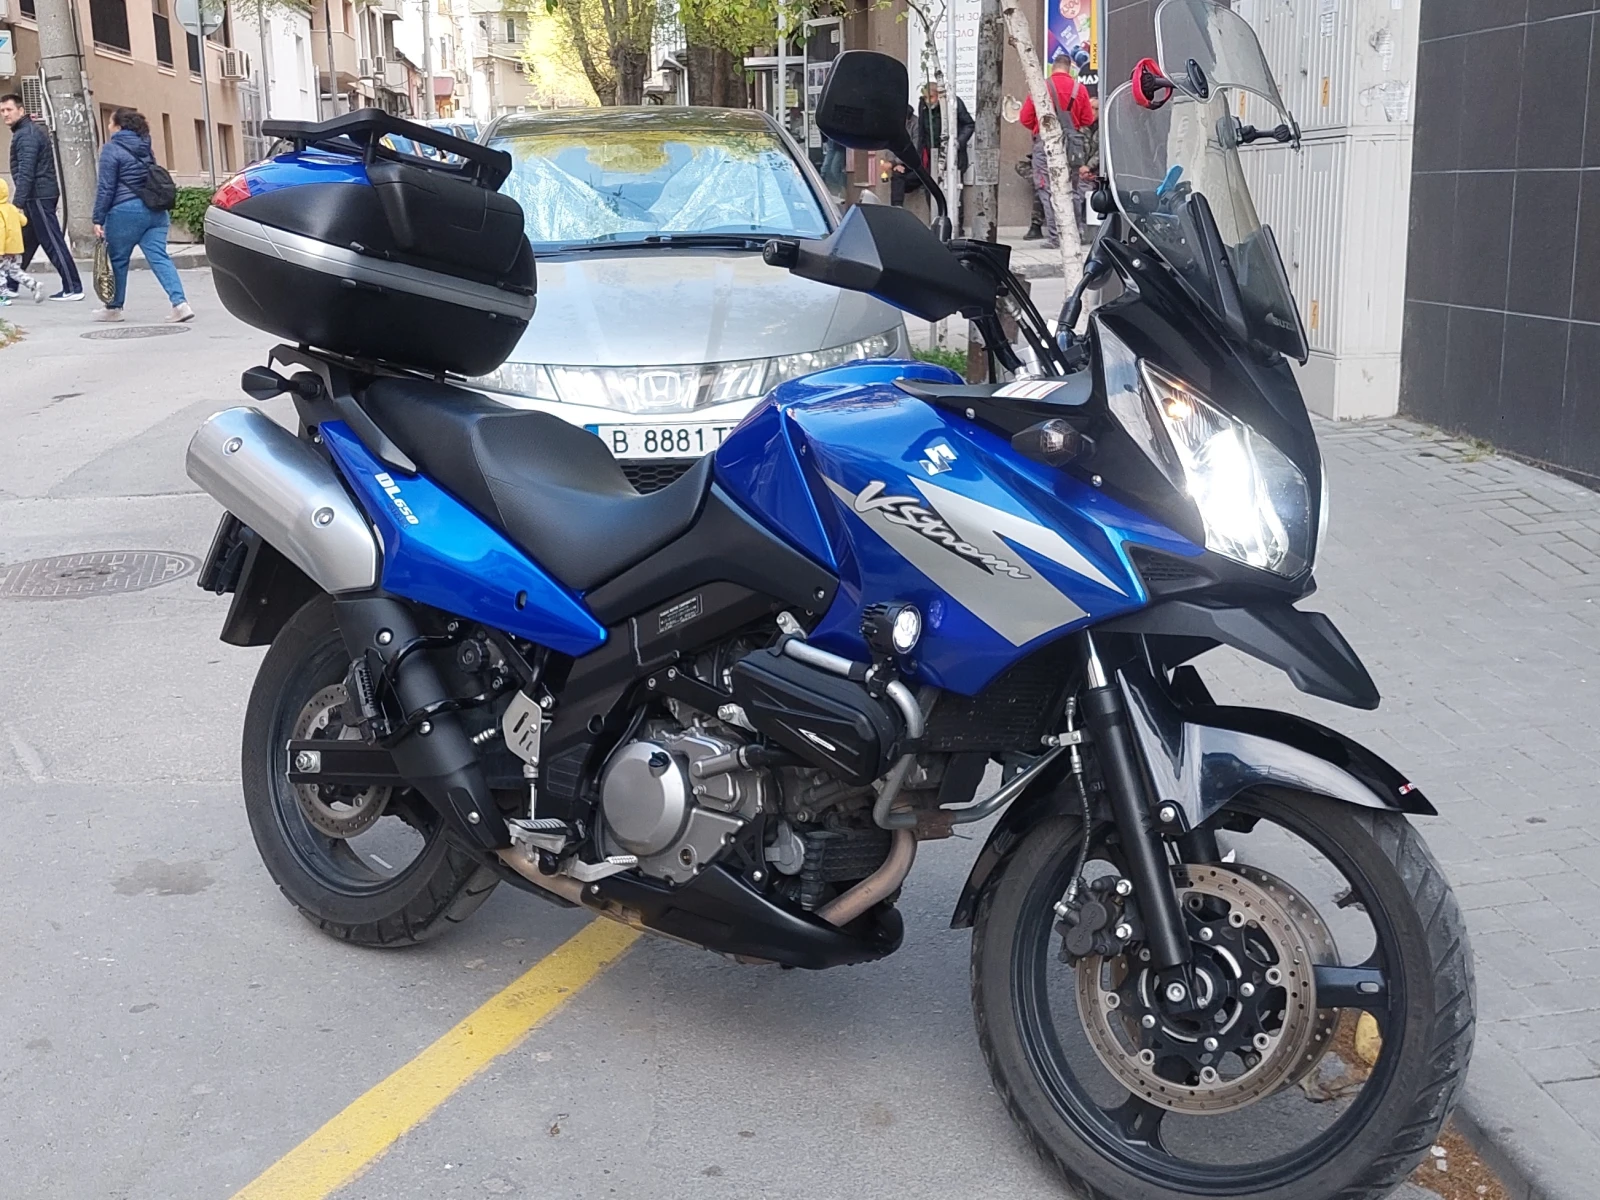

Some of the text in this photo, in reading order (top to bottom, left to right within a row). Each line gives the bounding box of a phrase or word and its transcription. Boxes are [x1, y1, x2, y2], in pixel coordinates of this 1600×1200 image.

[613, 427, 739, 453] B 8881 T
